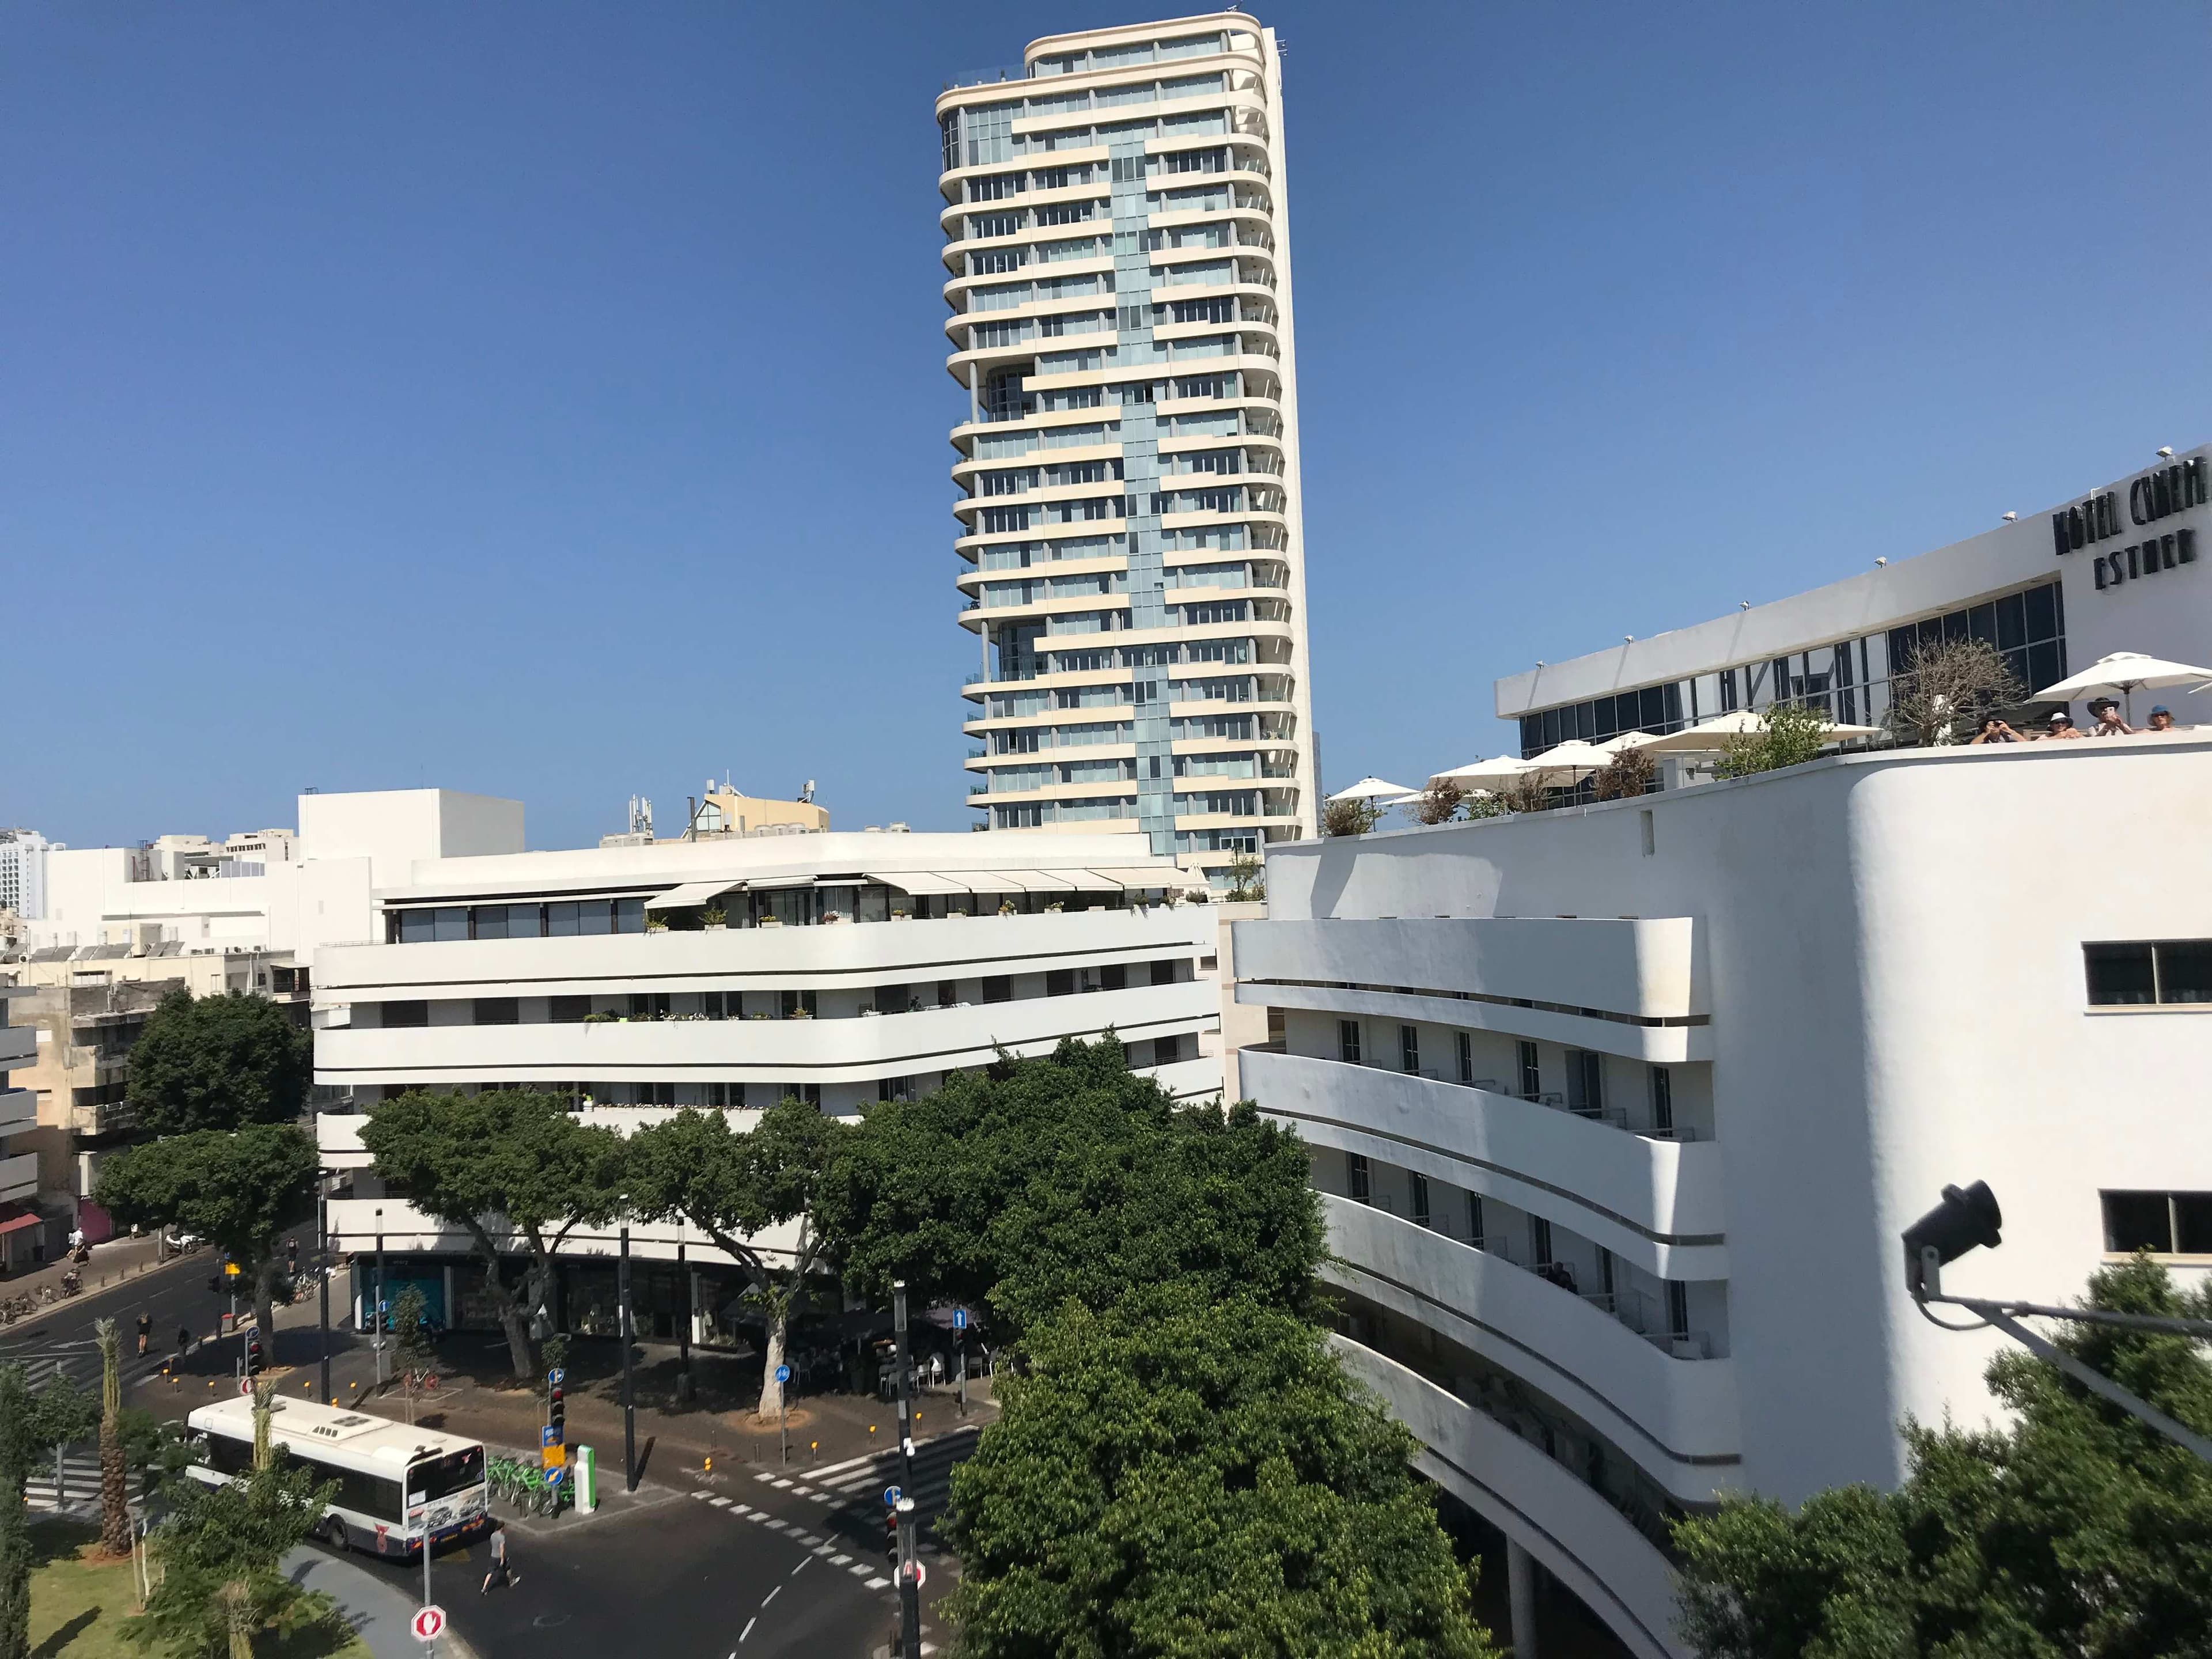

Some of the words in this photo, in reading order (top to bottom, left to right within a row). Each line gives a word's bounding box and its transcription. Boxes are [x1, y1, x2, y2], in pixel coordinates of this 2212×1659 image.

[2052, 491, 2122, 556] HOTEL
[2129, 456, 2212, 525] CINEM
[2093, 528, 2196, 590] ESTHER
